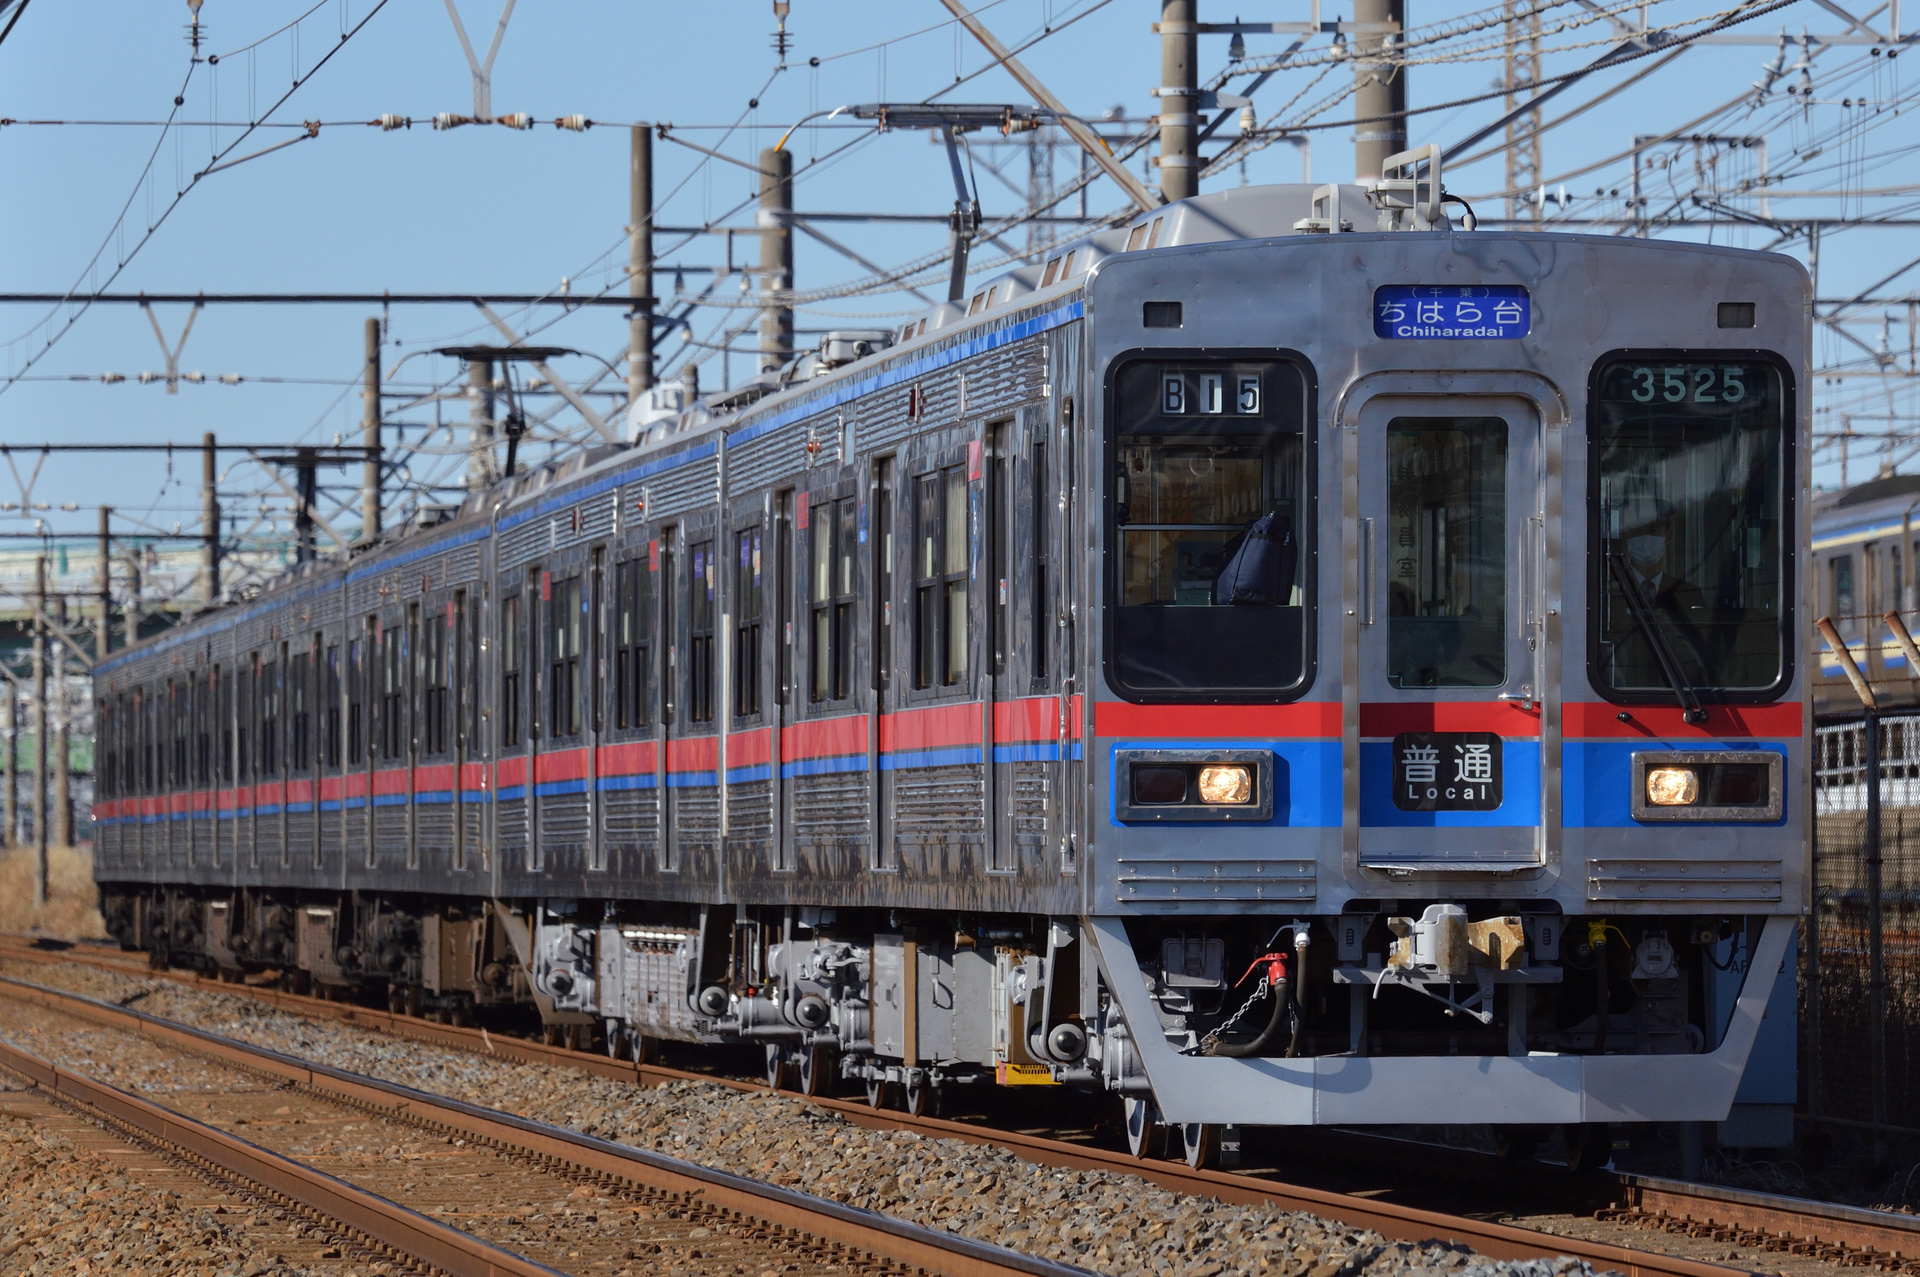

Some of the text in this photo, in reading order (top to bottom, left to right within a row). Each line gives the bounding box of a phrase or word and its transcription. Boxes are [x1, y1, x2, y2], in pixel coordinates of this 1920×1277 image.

[1379, 300, 1523, 324] ちはら台
[1397, 325, 1504, 337] Chiharadai
[1631, 367, 1746, 403] 3525
[1401, 743, 1493, 783] 普通
[1408, 784, 1486, 800] Local
